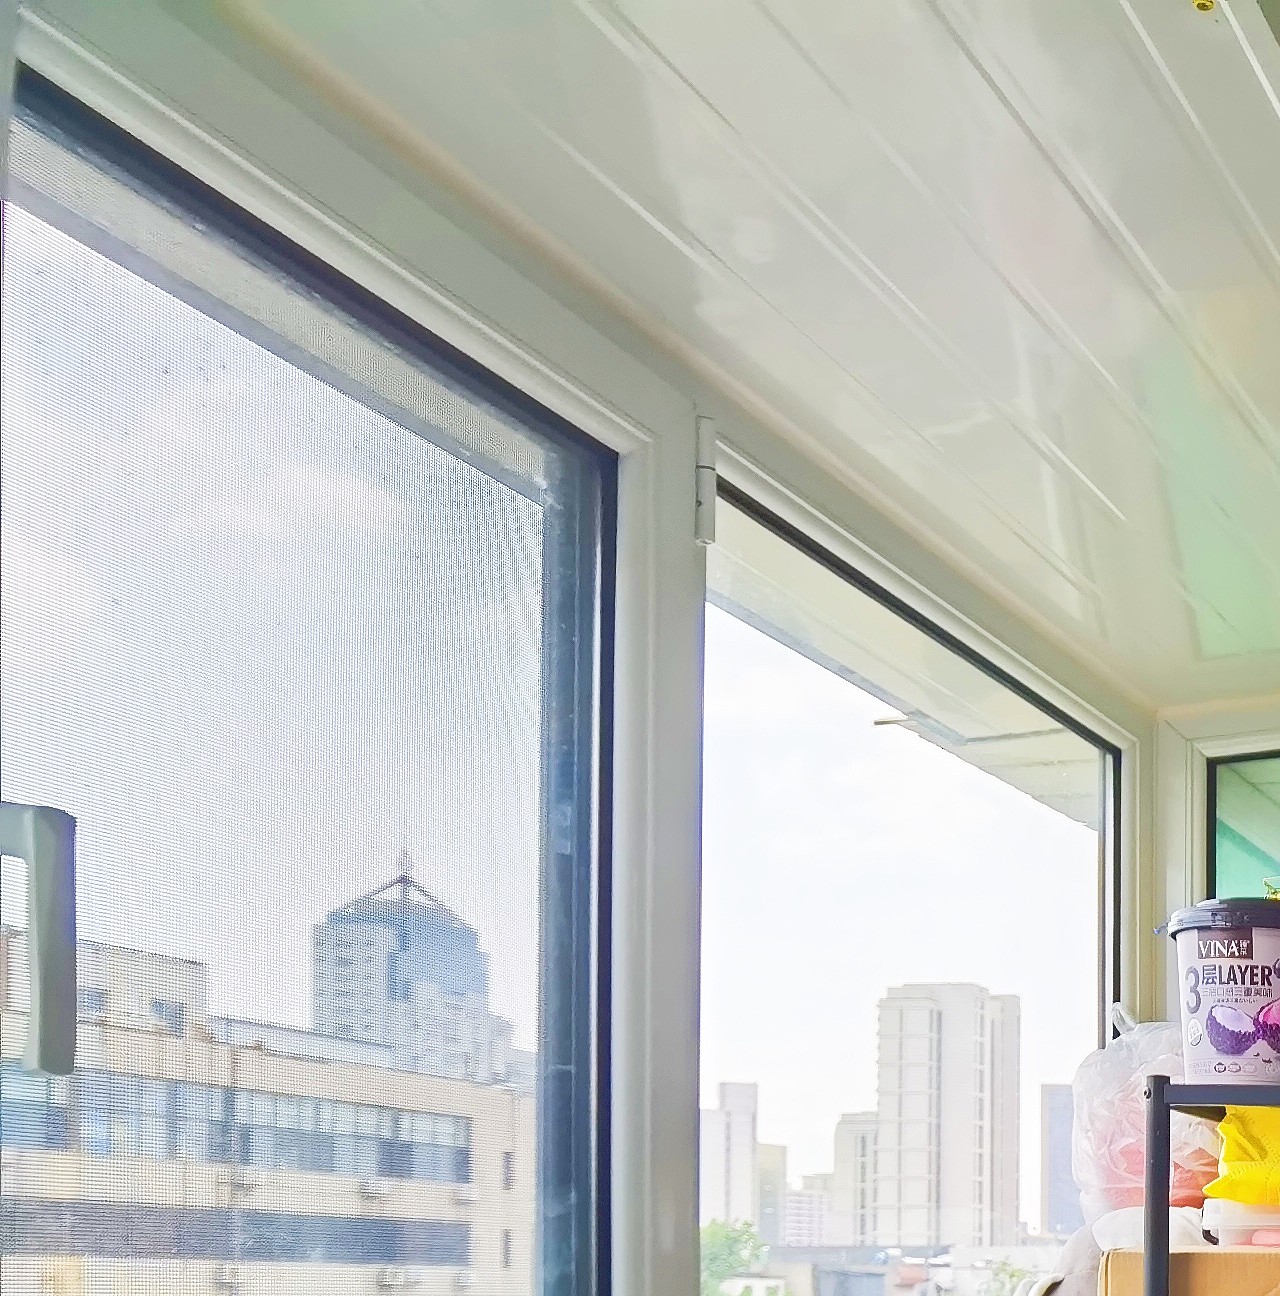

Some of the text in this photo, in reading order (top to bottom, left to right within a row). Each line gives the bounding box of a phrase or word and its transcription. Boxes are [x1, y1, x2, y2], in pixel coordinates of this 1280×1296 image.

[1199, 940, 1240, 958] VINA
[1218, 964, 1273, 987] LAYER
[1185, 966, 1202, 1014] 3
